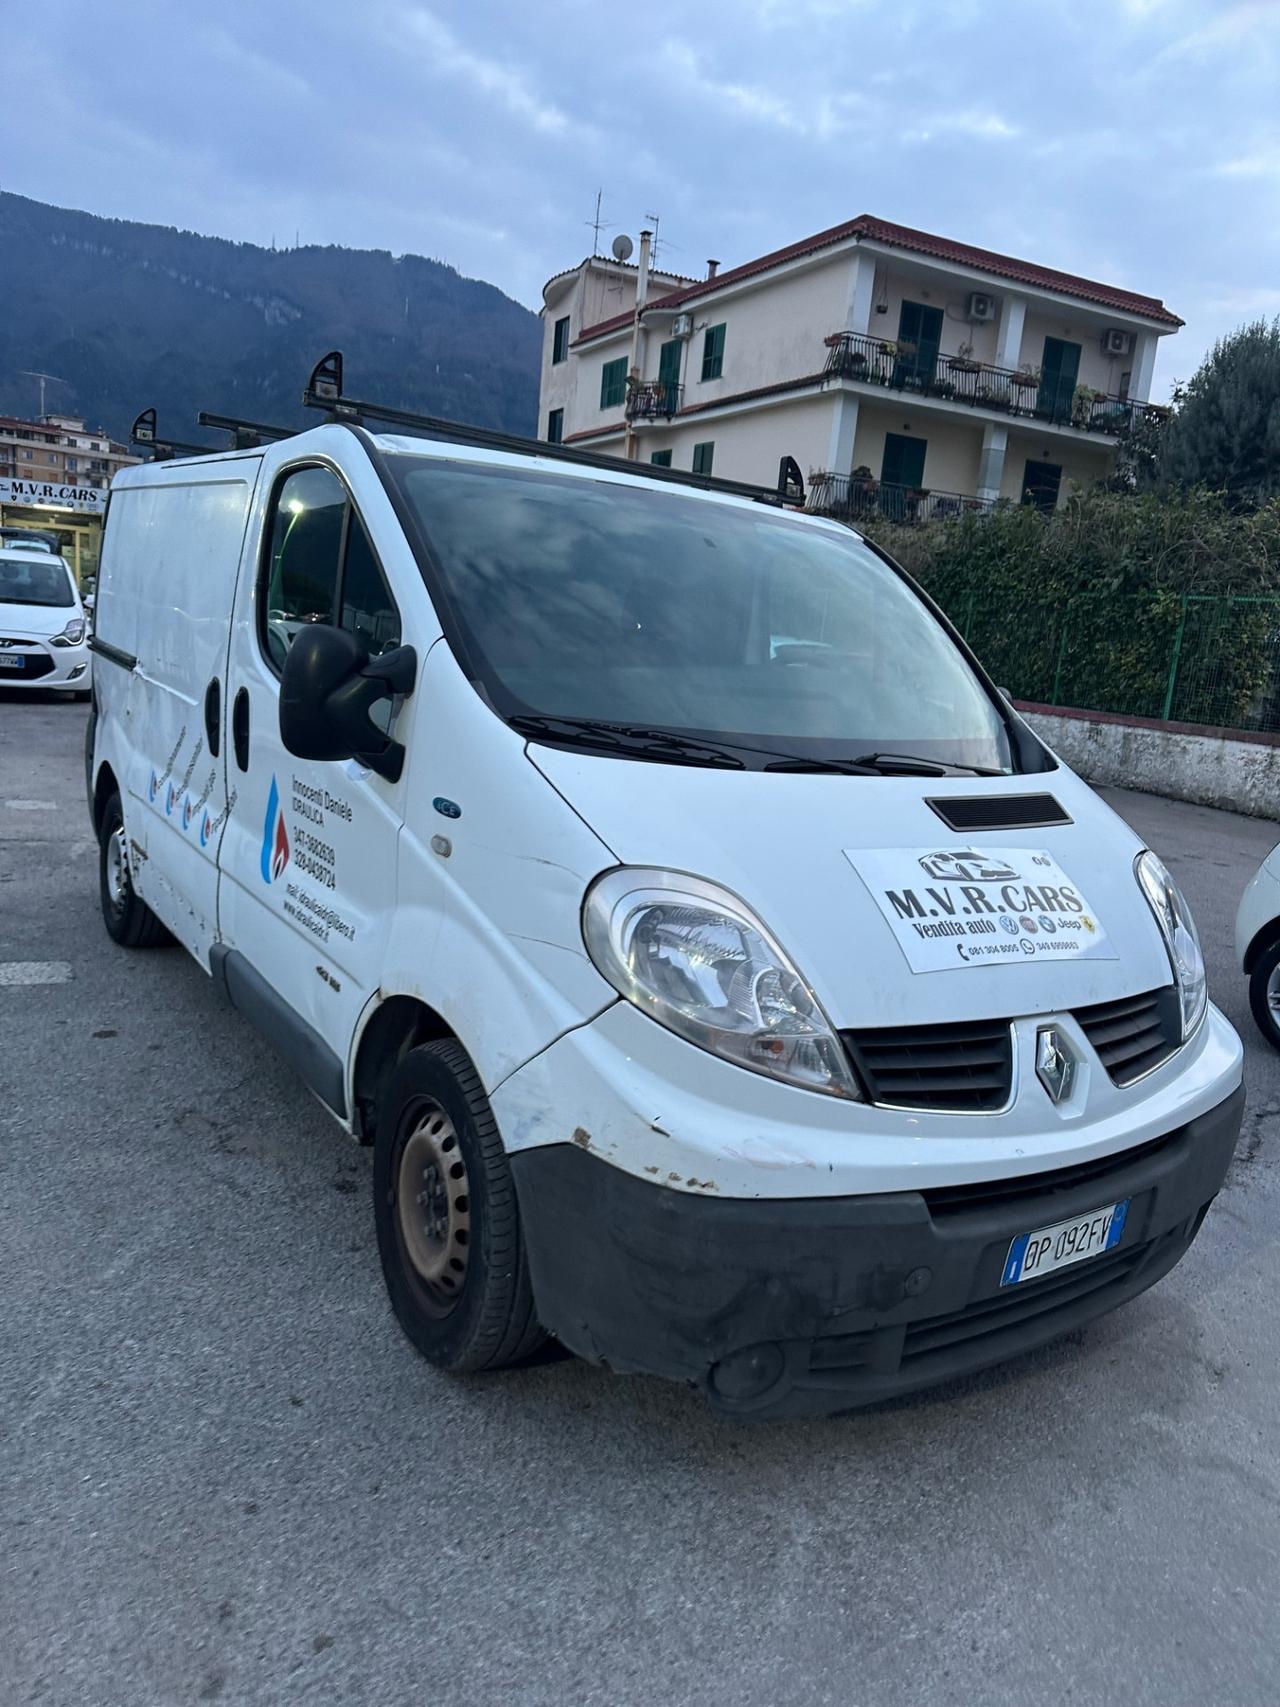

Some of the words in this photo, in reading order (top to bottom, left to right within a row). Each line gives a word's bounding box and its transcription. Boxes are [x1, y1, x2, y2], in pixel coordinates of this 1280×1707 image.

[292, 774, 323, 807] Innocenti
[324, 790, 353, 823] Daniele
[293, 797, 325, 828] IDRAULICA
[885, 885, 1084, 919] M.V.R.CARS
[912, 919, 967, 939] Vendita
[966, 917, 997, 935] auto
[1058, 917, 1082, 930] Jeep
[1024, 1238, 1052, 1272] DP
[1054, 1215, 1112, 1260] 092FV
